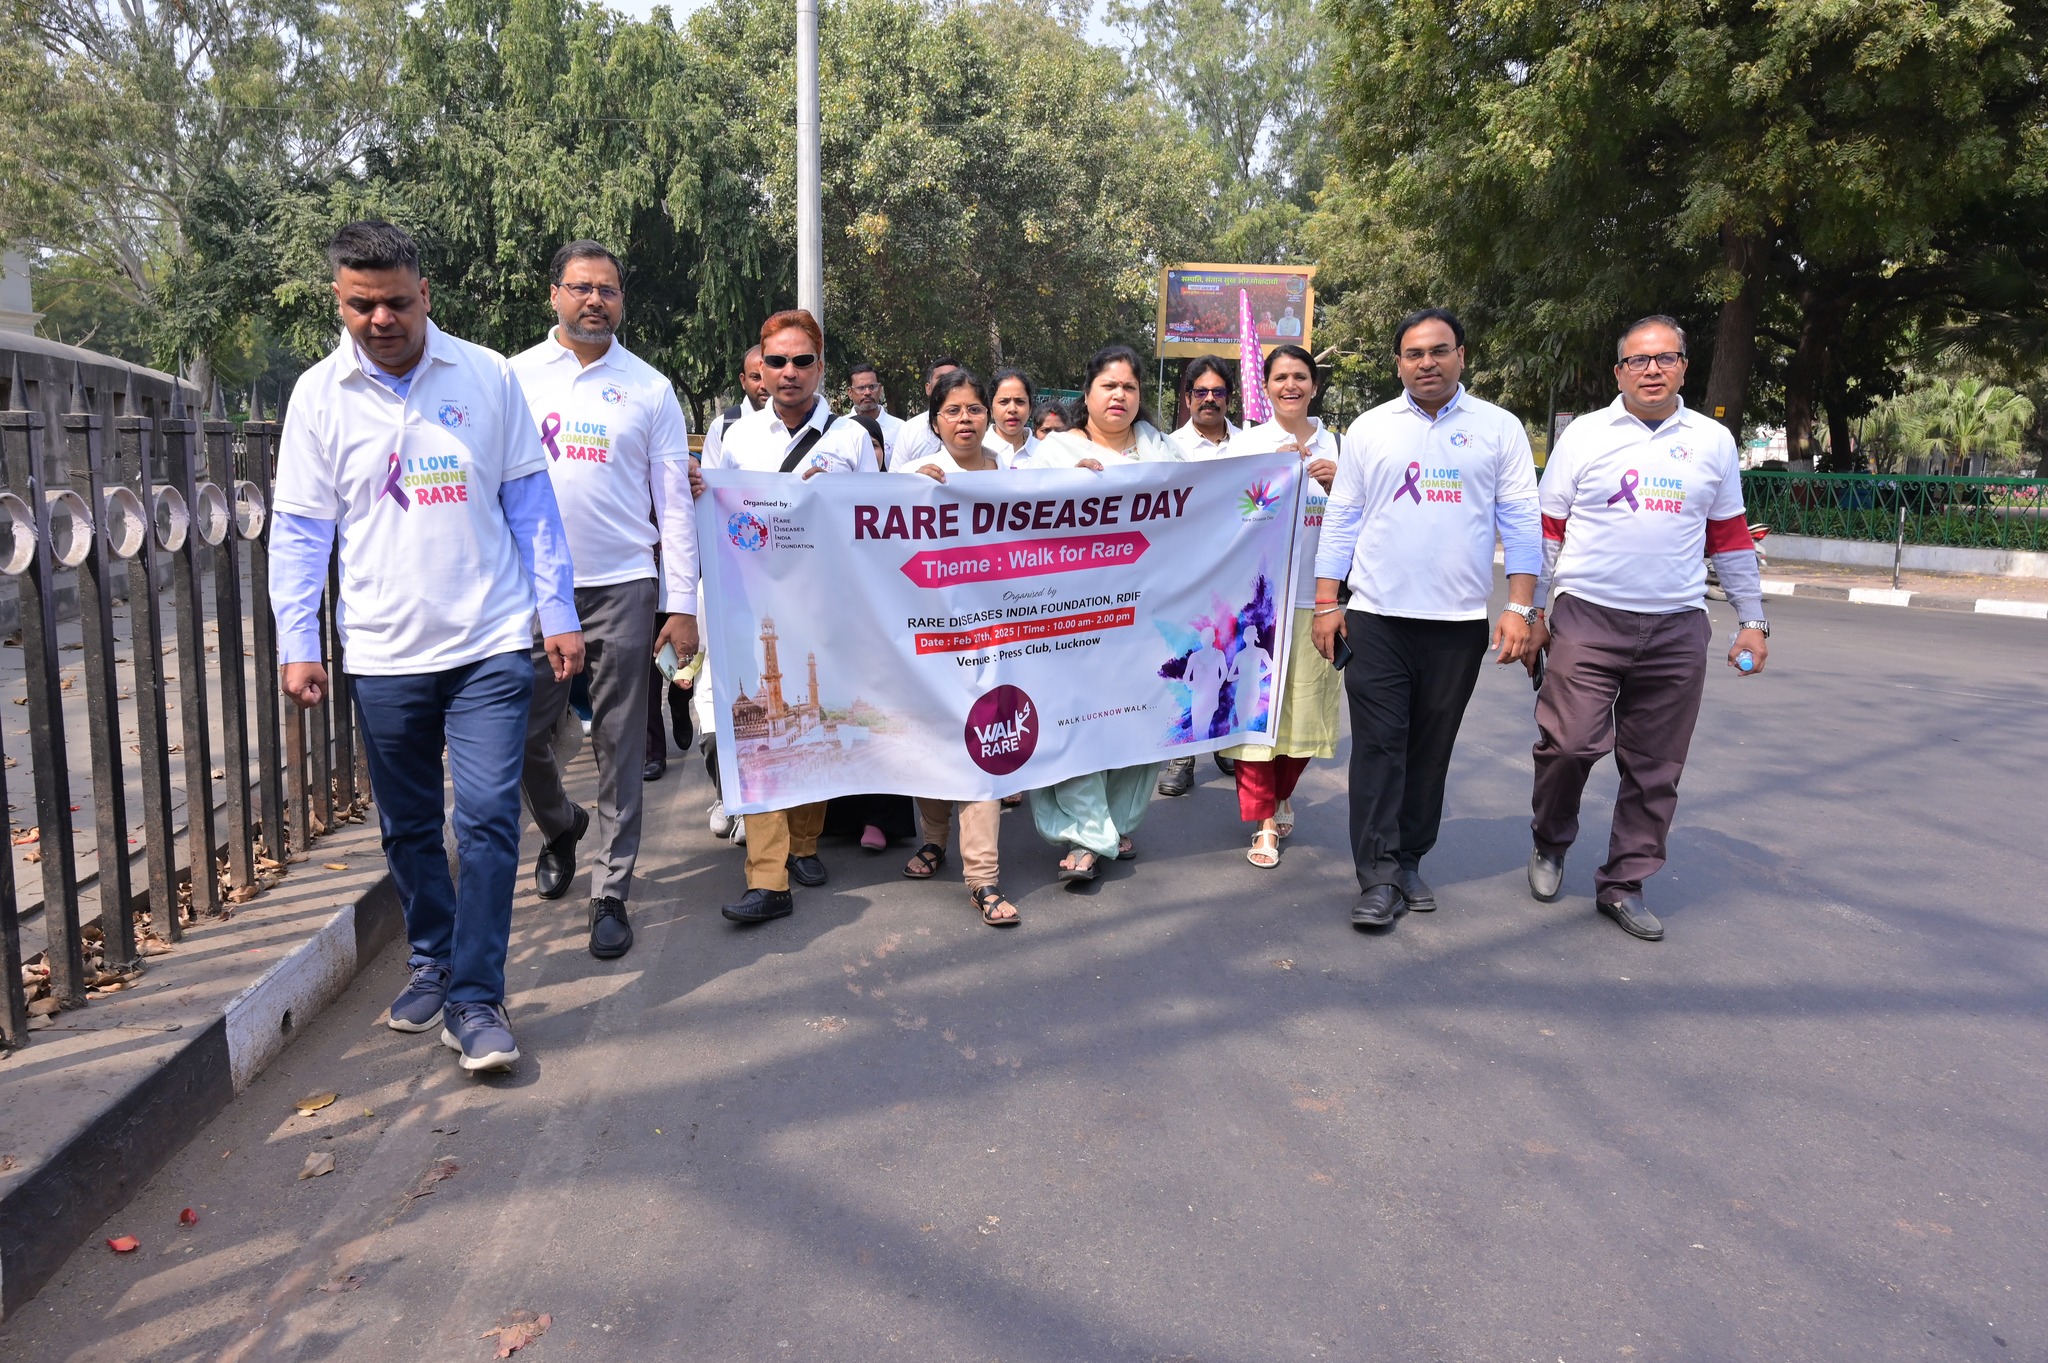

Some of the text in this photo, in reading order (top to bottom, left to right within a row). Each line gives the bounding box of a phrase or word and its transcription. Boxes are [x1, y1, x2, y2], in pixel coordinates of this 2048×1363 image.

[565, 421, 607, 436] I LOVE
[560, 434, 611, 449] SOMEONE
[566, 445, 607, 463] RARE
[407, 455, 459, 473] I LOVE
[404, 470, 467, 488] SOMEONE
[1424, 469, 1459, 479] I LOVE
[1420, 480, 1463, 490] SOMEONE
[1643, 477, 1683, 490] I LOVE
[415, 484, 468, 506] RARE
[1426, 490, 1462, 503] RARE
[1638, 488, 1687, 501] SOMEONE
[743, 499, 778, 508] Organised
[779, 500, 788, 509] by
[1645, 498, 1683, 514] RARE
[854, 486, 1194, 540] RARE DISEASE DAY
[921, 557, 990, 580] Theme
[1008, 548, 1054, 570] Walk
[1059, 544, 1087, 562] for
[1091, 540, 1134, 559] Rare
[1002, 586, 1057, 603] Organised by
[907, 590, 1141, 629] RARE DISEASES INDIA FOUNDATION, RDIF
[920, 636, 945, 648] Date
[953, 634, 972, 646] Feb
[993, 626, 1015, 640] 2025
[1022, 624, 1045, 636] Time
[1052, 618, 1076, 631] 10.00
[1076, 616, 1095, 628] am-
[1096, 614, 1115, 626] 2.00
[1116, 611, 1131, 625] pm
[956, 653, 991, 668] Venue
[998, 646, 1023, 661] Press
[1024, 642, 1051, 656] Club,
[1055, 635, 1101, 652] Lucknow
[1057, 715, 1081, 727] WALK
[1081, 708, 1123, 722] LUCKNOW
[1123, 703, 1148, 714] WALK
[980, 741, 1020, 758] RARE
